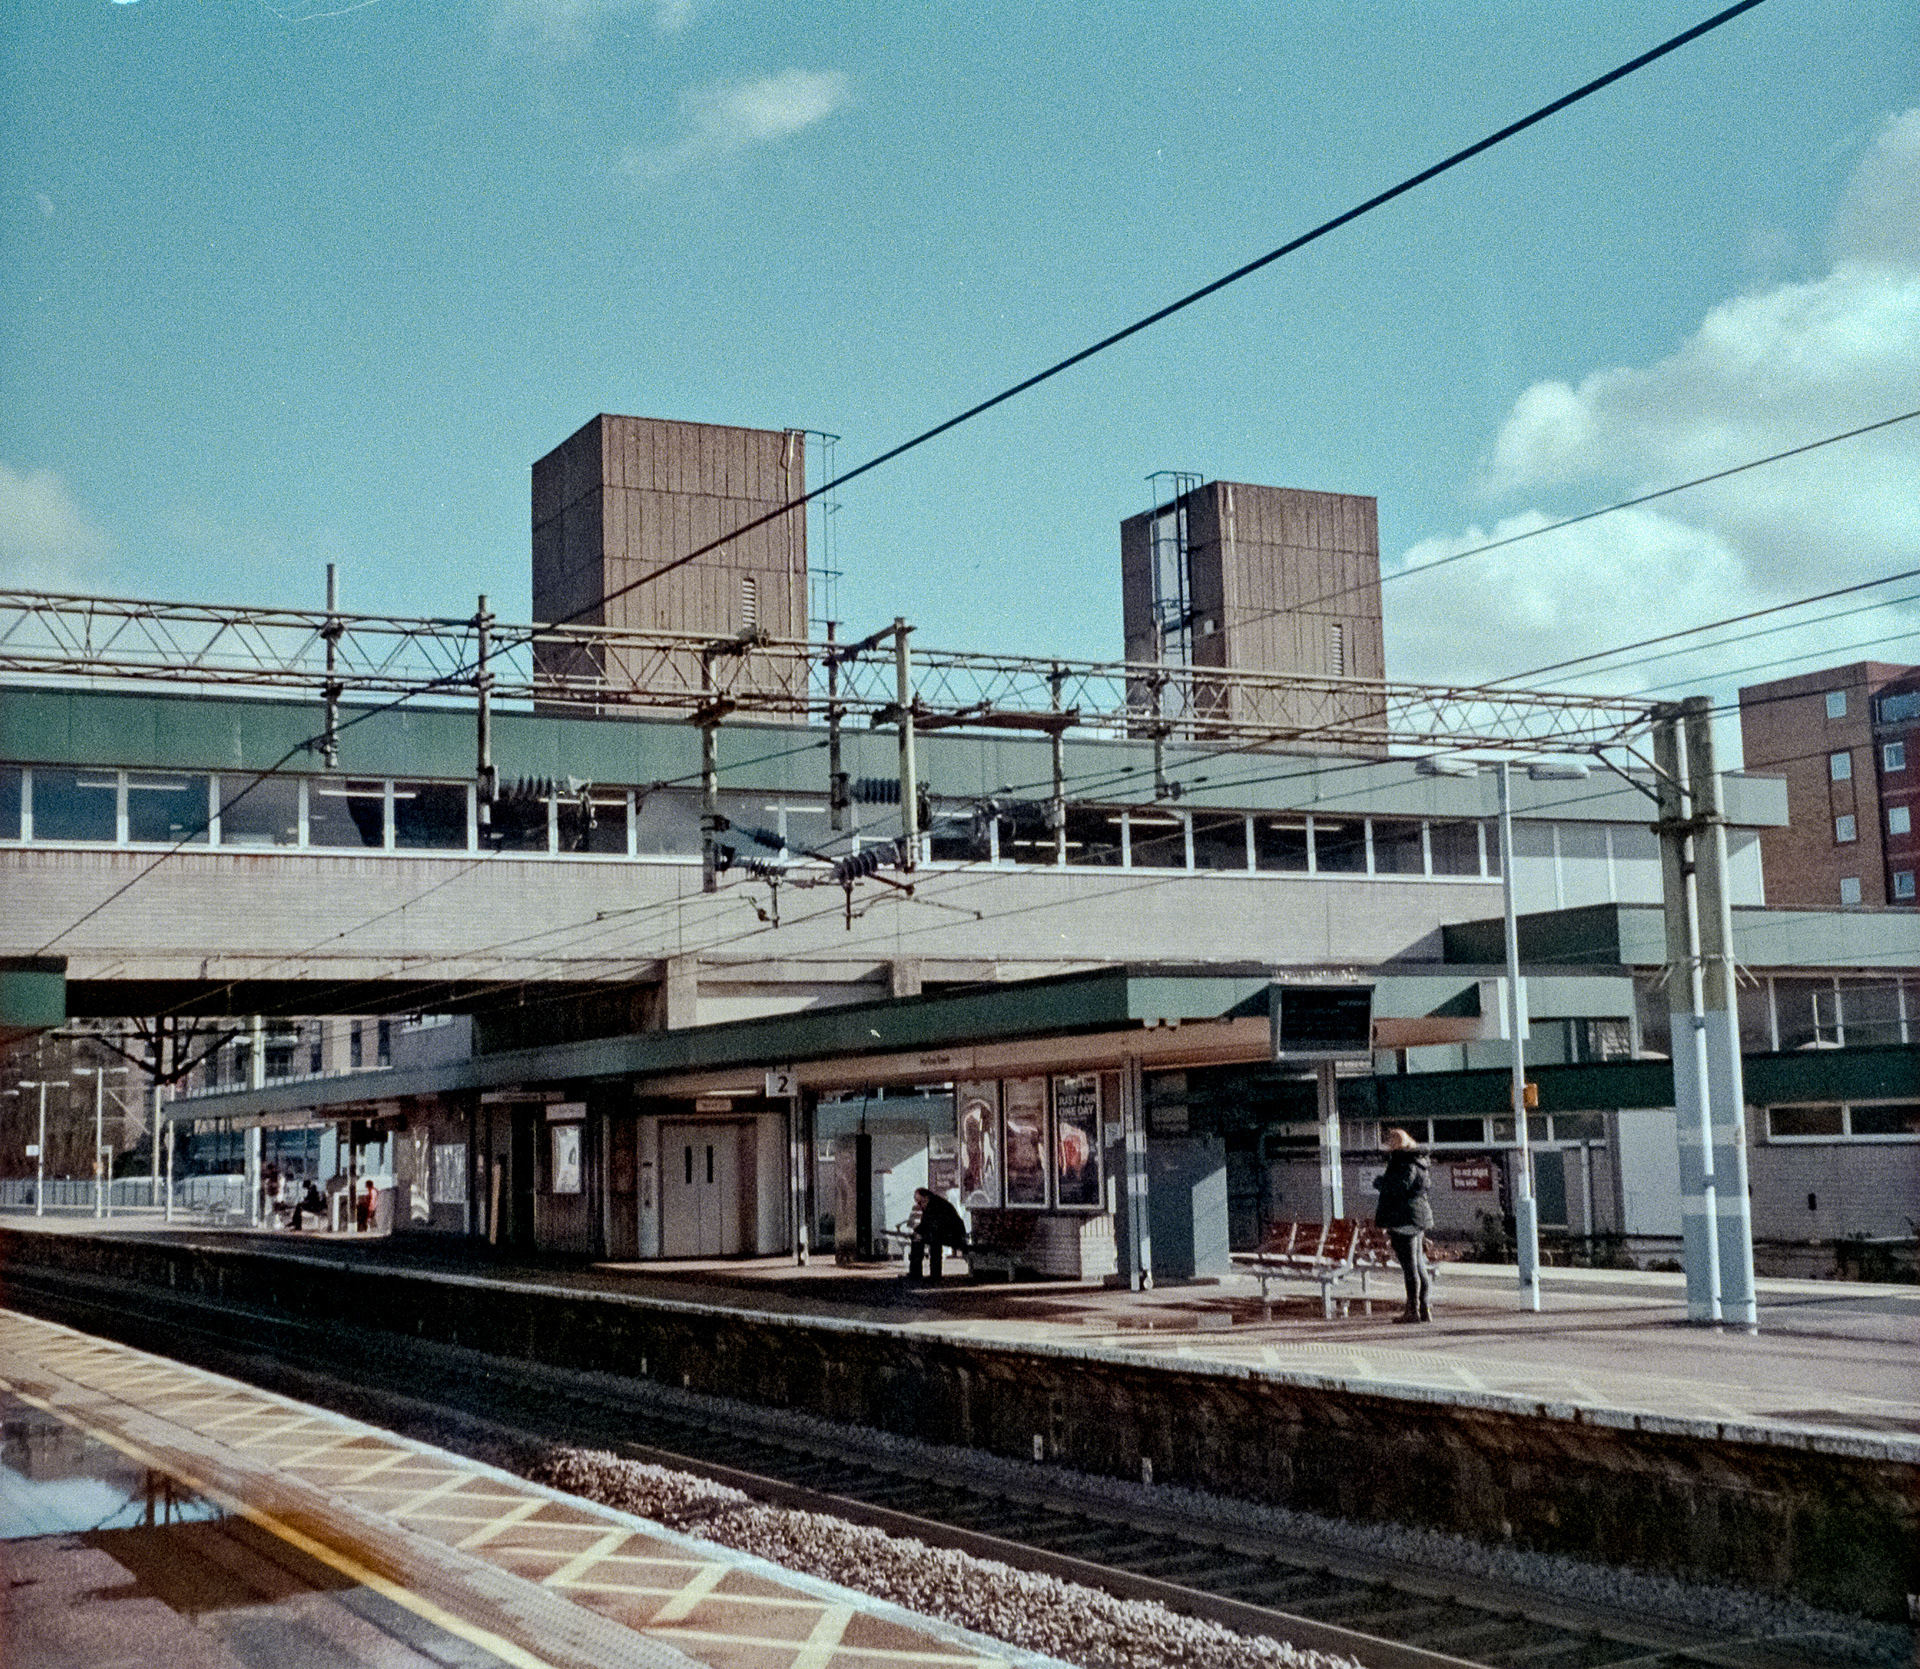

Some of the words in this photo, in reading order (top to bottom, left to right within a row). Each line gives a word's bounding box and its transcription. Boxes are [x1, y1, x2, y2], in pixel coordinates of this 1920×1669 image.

[777, 1075, 789, 1093] 2
[1059, 1106, 1076, 1116] ONE
[1077, 1104, 1095, 1115] DAY
